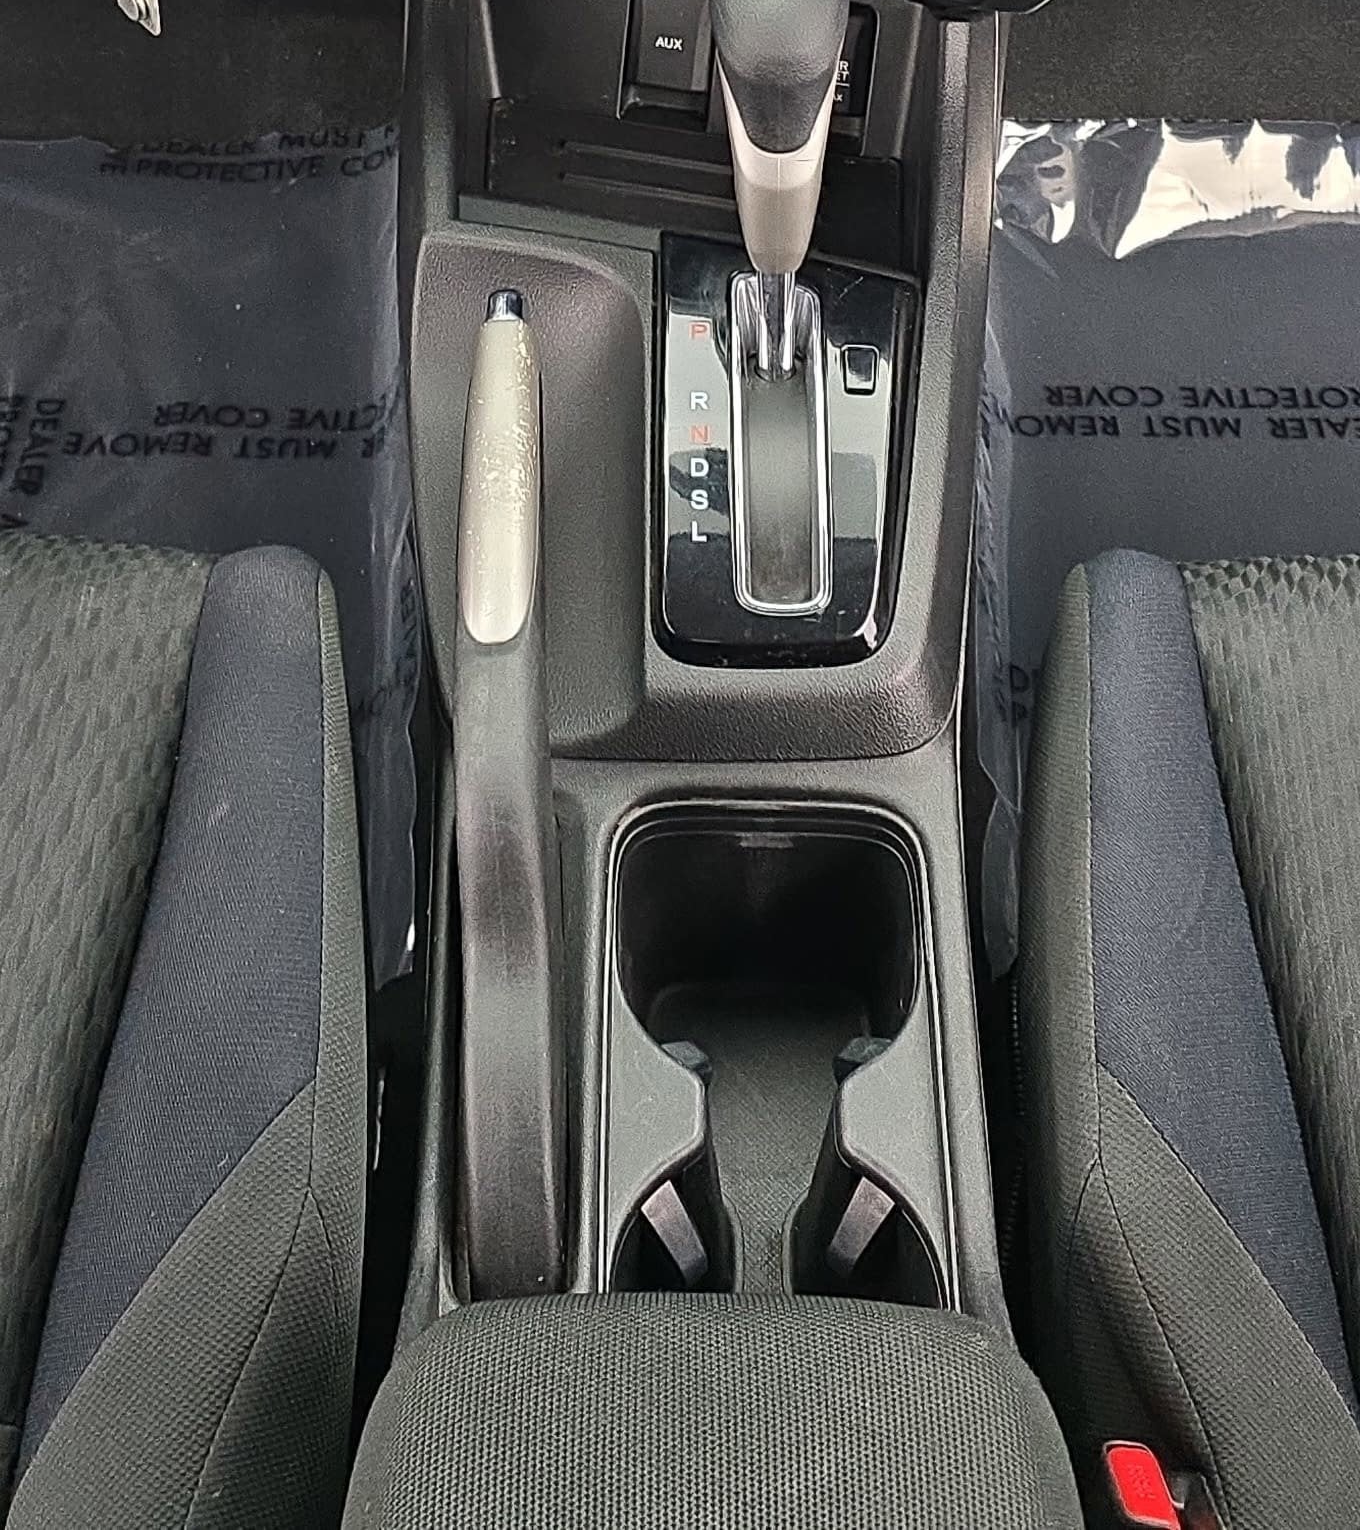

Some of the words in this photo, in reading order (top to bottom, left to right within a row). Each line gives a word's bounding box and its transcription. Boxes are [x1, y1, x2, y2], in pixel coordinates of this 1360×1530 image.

[655, 36, 683, 52] AUX
[691, 324, 709, 341] P
[690, 391, 710, 410] R
[1044, 384, 1165, 407] COVER
[153, 401, 268, 430] COVER
[690, 425, 711, 445] N
[1141, 415, 1242, 439] MUST
[238, 437, 338, 461] MUST
[690, 458, 710, 477] D
[690, 488, 710, 510] S
[691, 520, 708, 542] L
